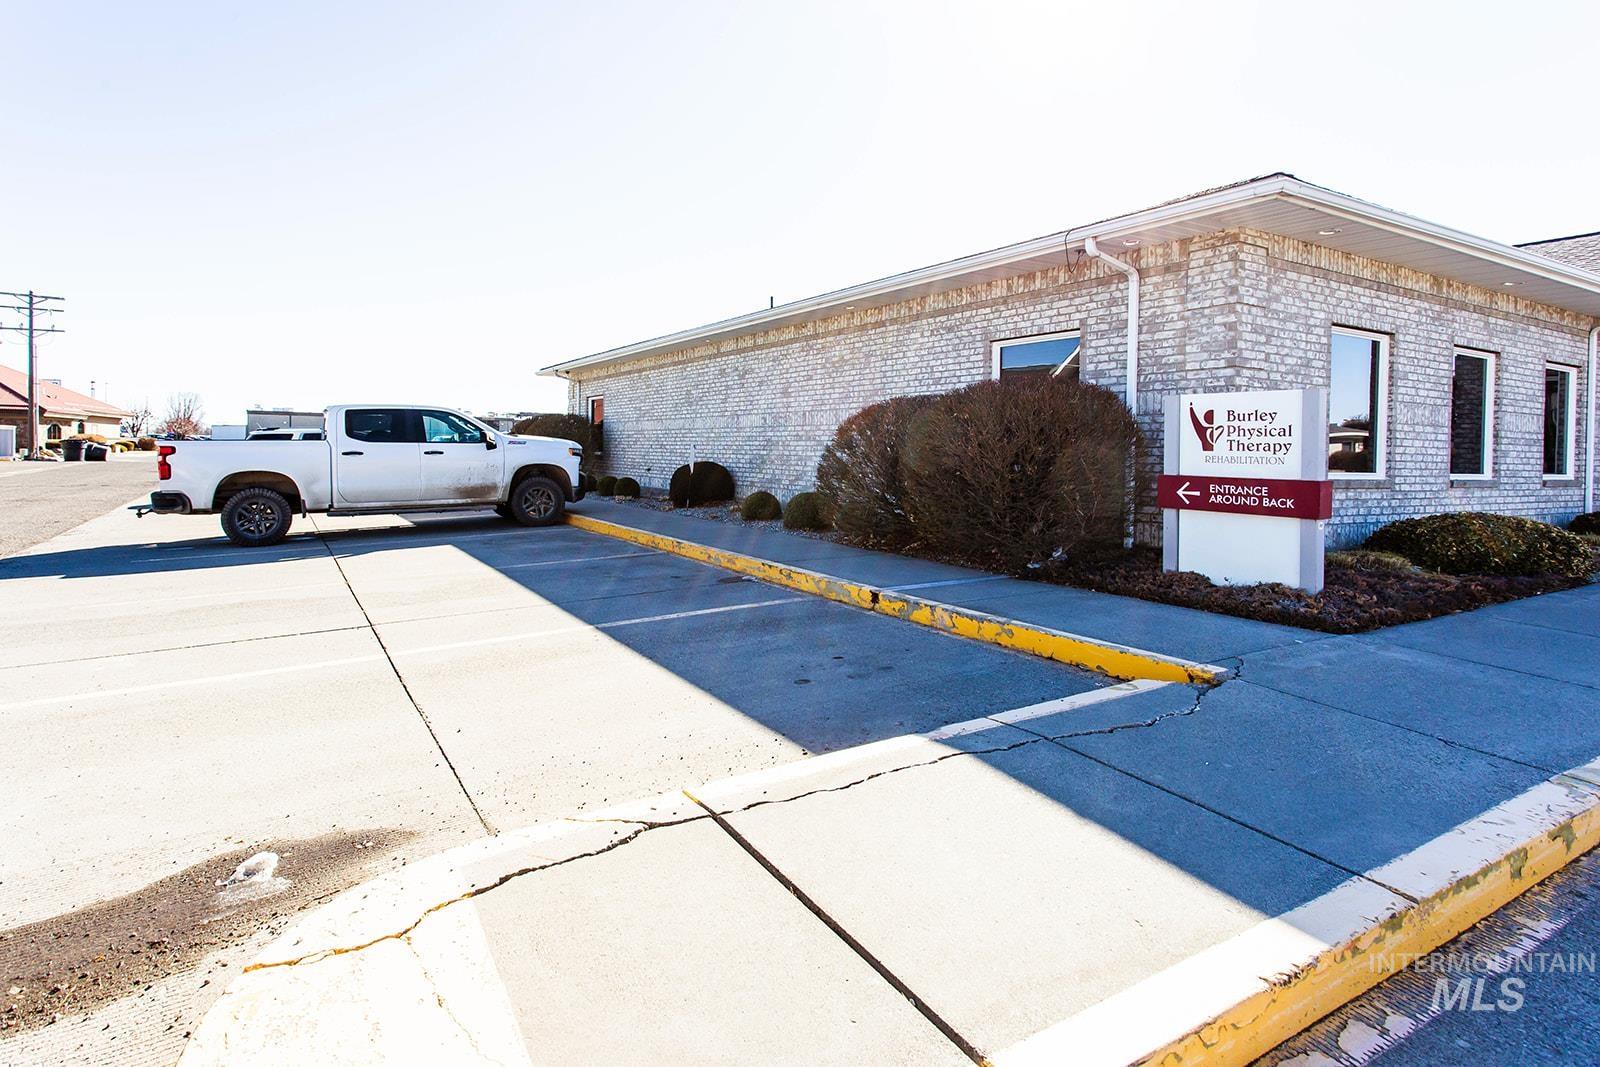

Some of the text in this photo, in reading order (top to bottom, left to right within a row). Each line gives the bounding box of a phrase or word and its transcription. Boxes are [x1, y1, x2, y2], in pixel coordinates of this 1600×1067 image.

[1227, 410, 1278, 424] Burley
[1226, 424, 1293, 440] Physical
[1226, 439, 1293, 455] Therapy
[1204, 455, 1286, 465] REHABILITATION
[1209, 484, 1269, 496] ENTRANCE
[1208, 495, 1295, 509] AROUND BACK
